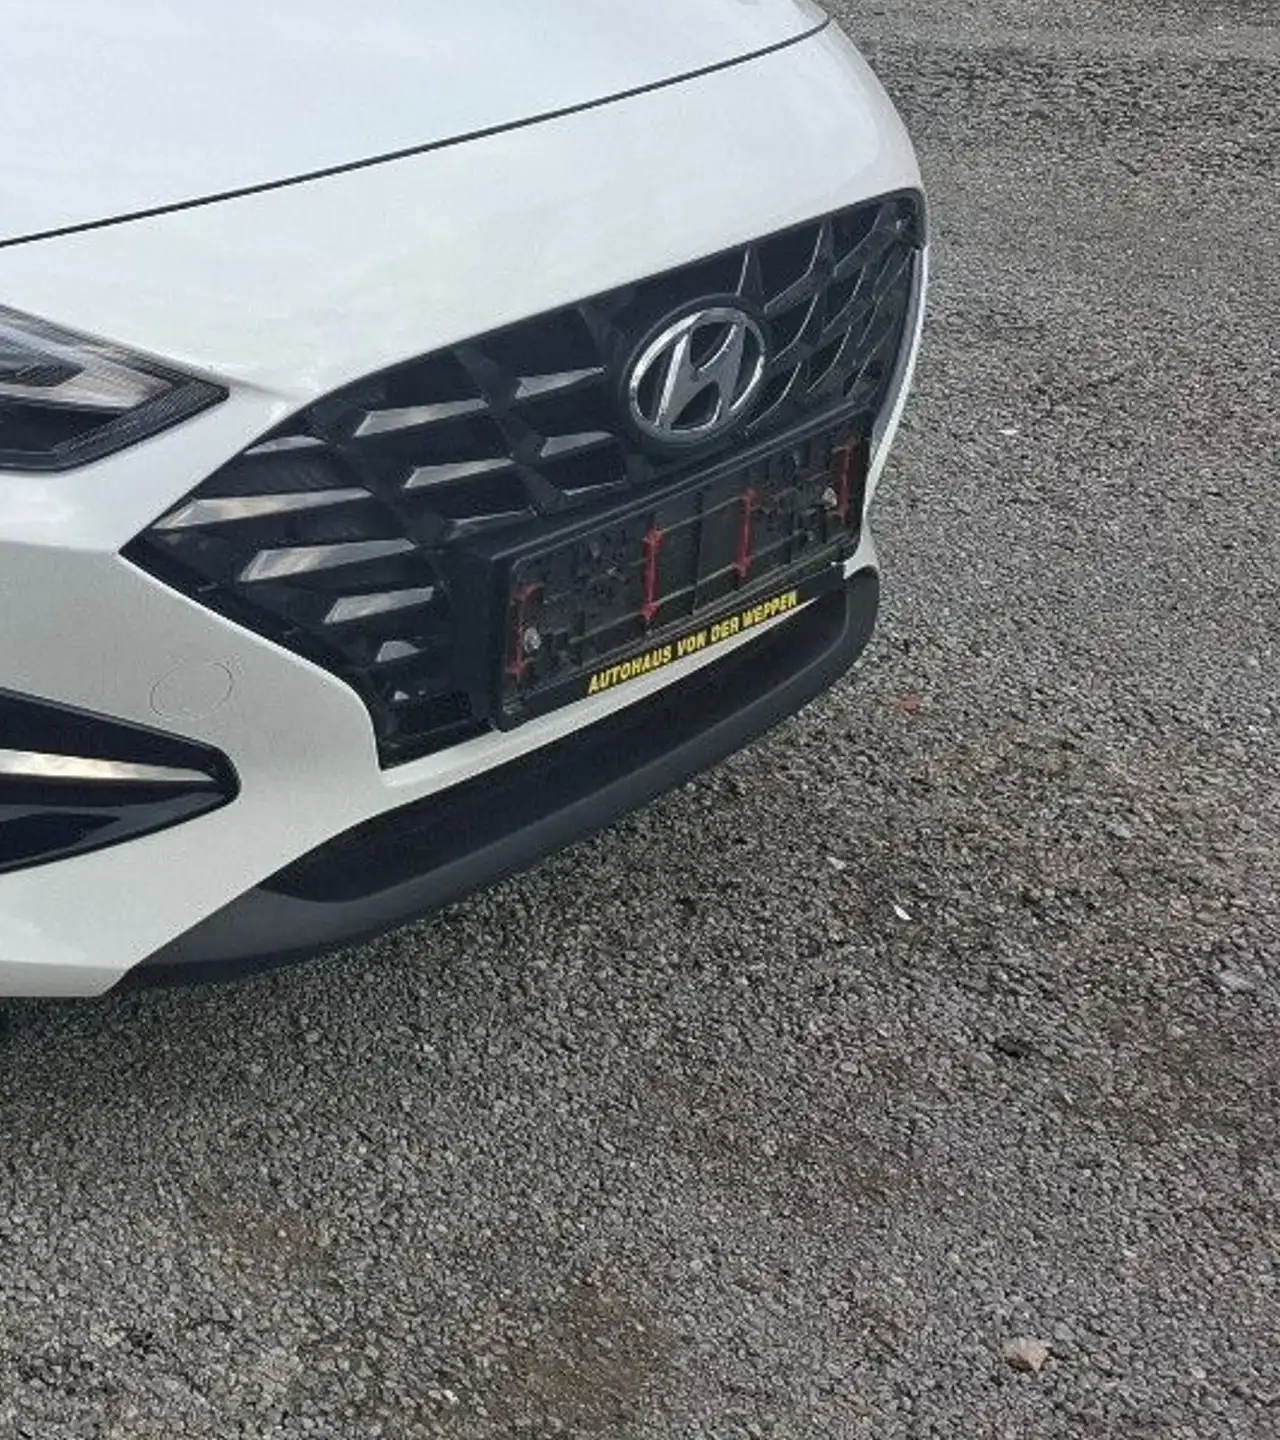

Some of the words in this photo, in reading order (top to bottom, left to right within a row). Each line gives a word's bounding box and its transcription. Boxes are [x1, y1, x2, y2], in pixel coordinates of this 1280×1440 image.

[589, 646, 672, 693] AUTOHAUS
[677, 630, 706, 657] VON
[710, 616, 740, 642] DER
